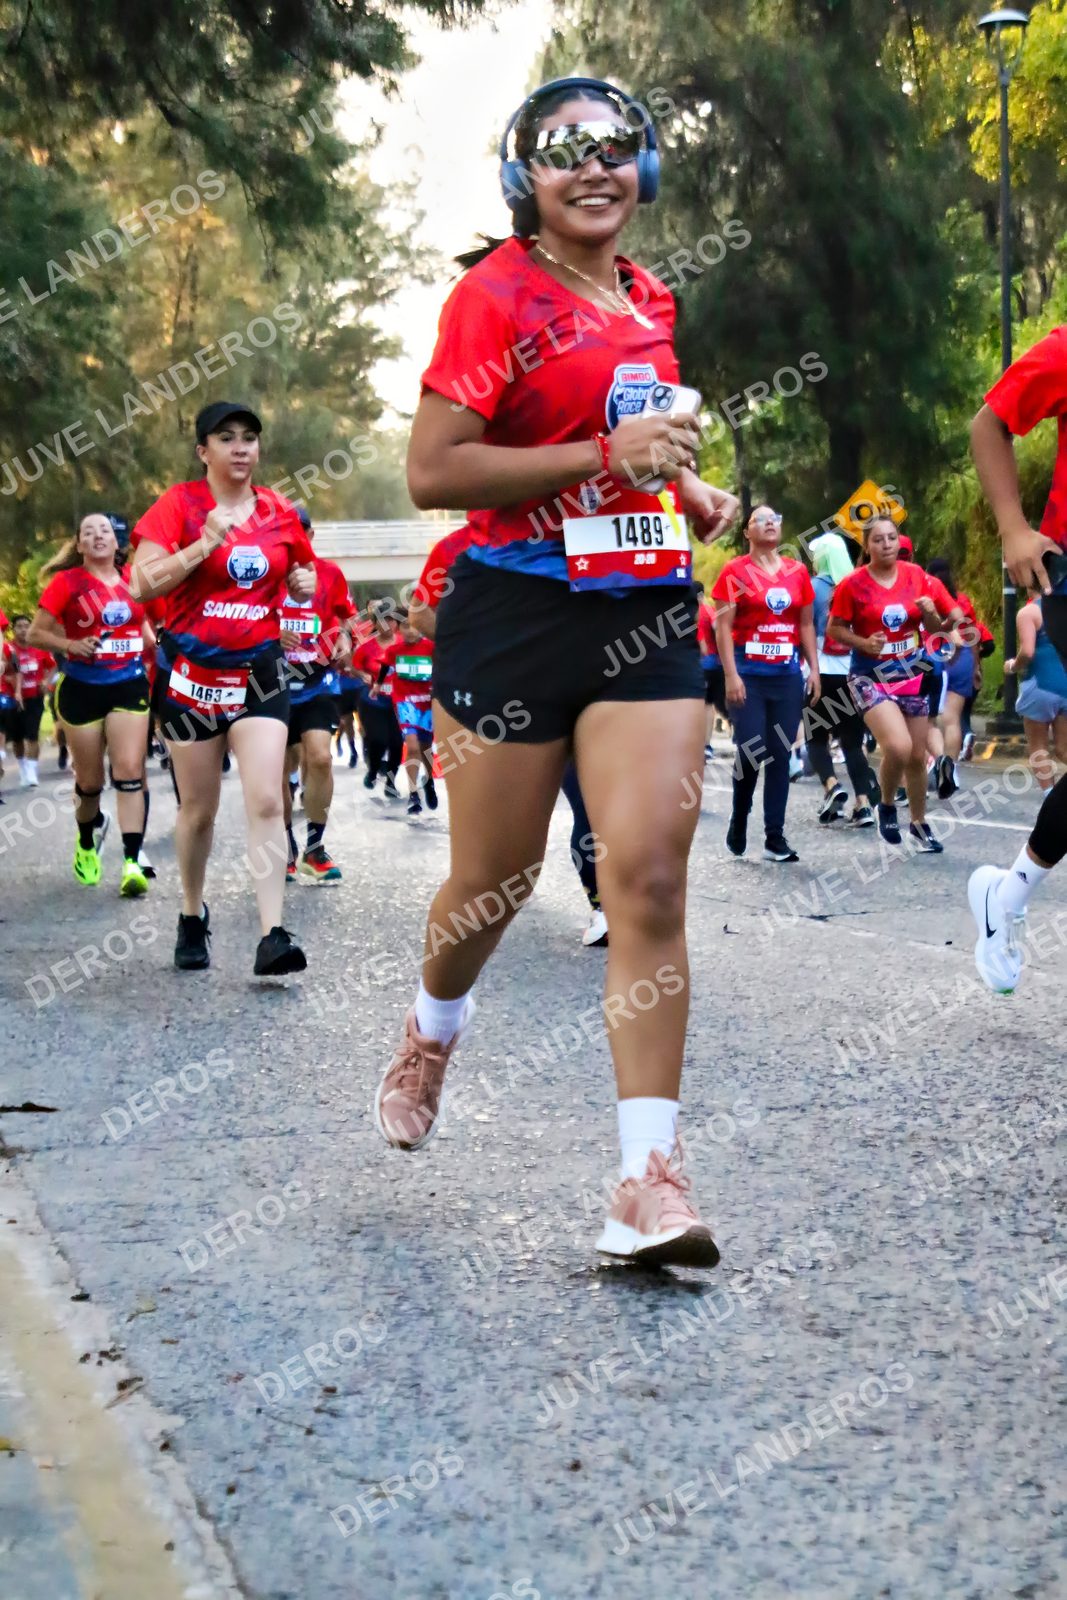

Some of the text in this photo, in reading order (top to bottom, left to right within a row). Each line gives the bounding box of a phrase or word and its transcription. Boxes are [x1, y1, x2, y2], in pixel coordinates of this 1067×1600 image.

[621, 373, 652, 382] BIMBO
[616, 401, 642, 414] Race
[611, 516, 664, 548] 1489
[761, 644, 781, 655] 1220
[191, 683, 222, 702] 1463
